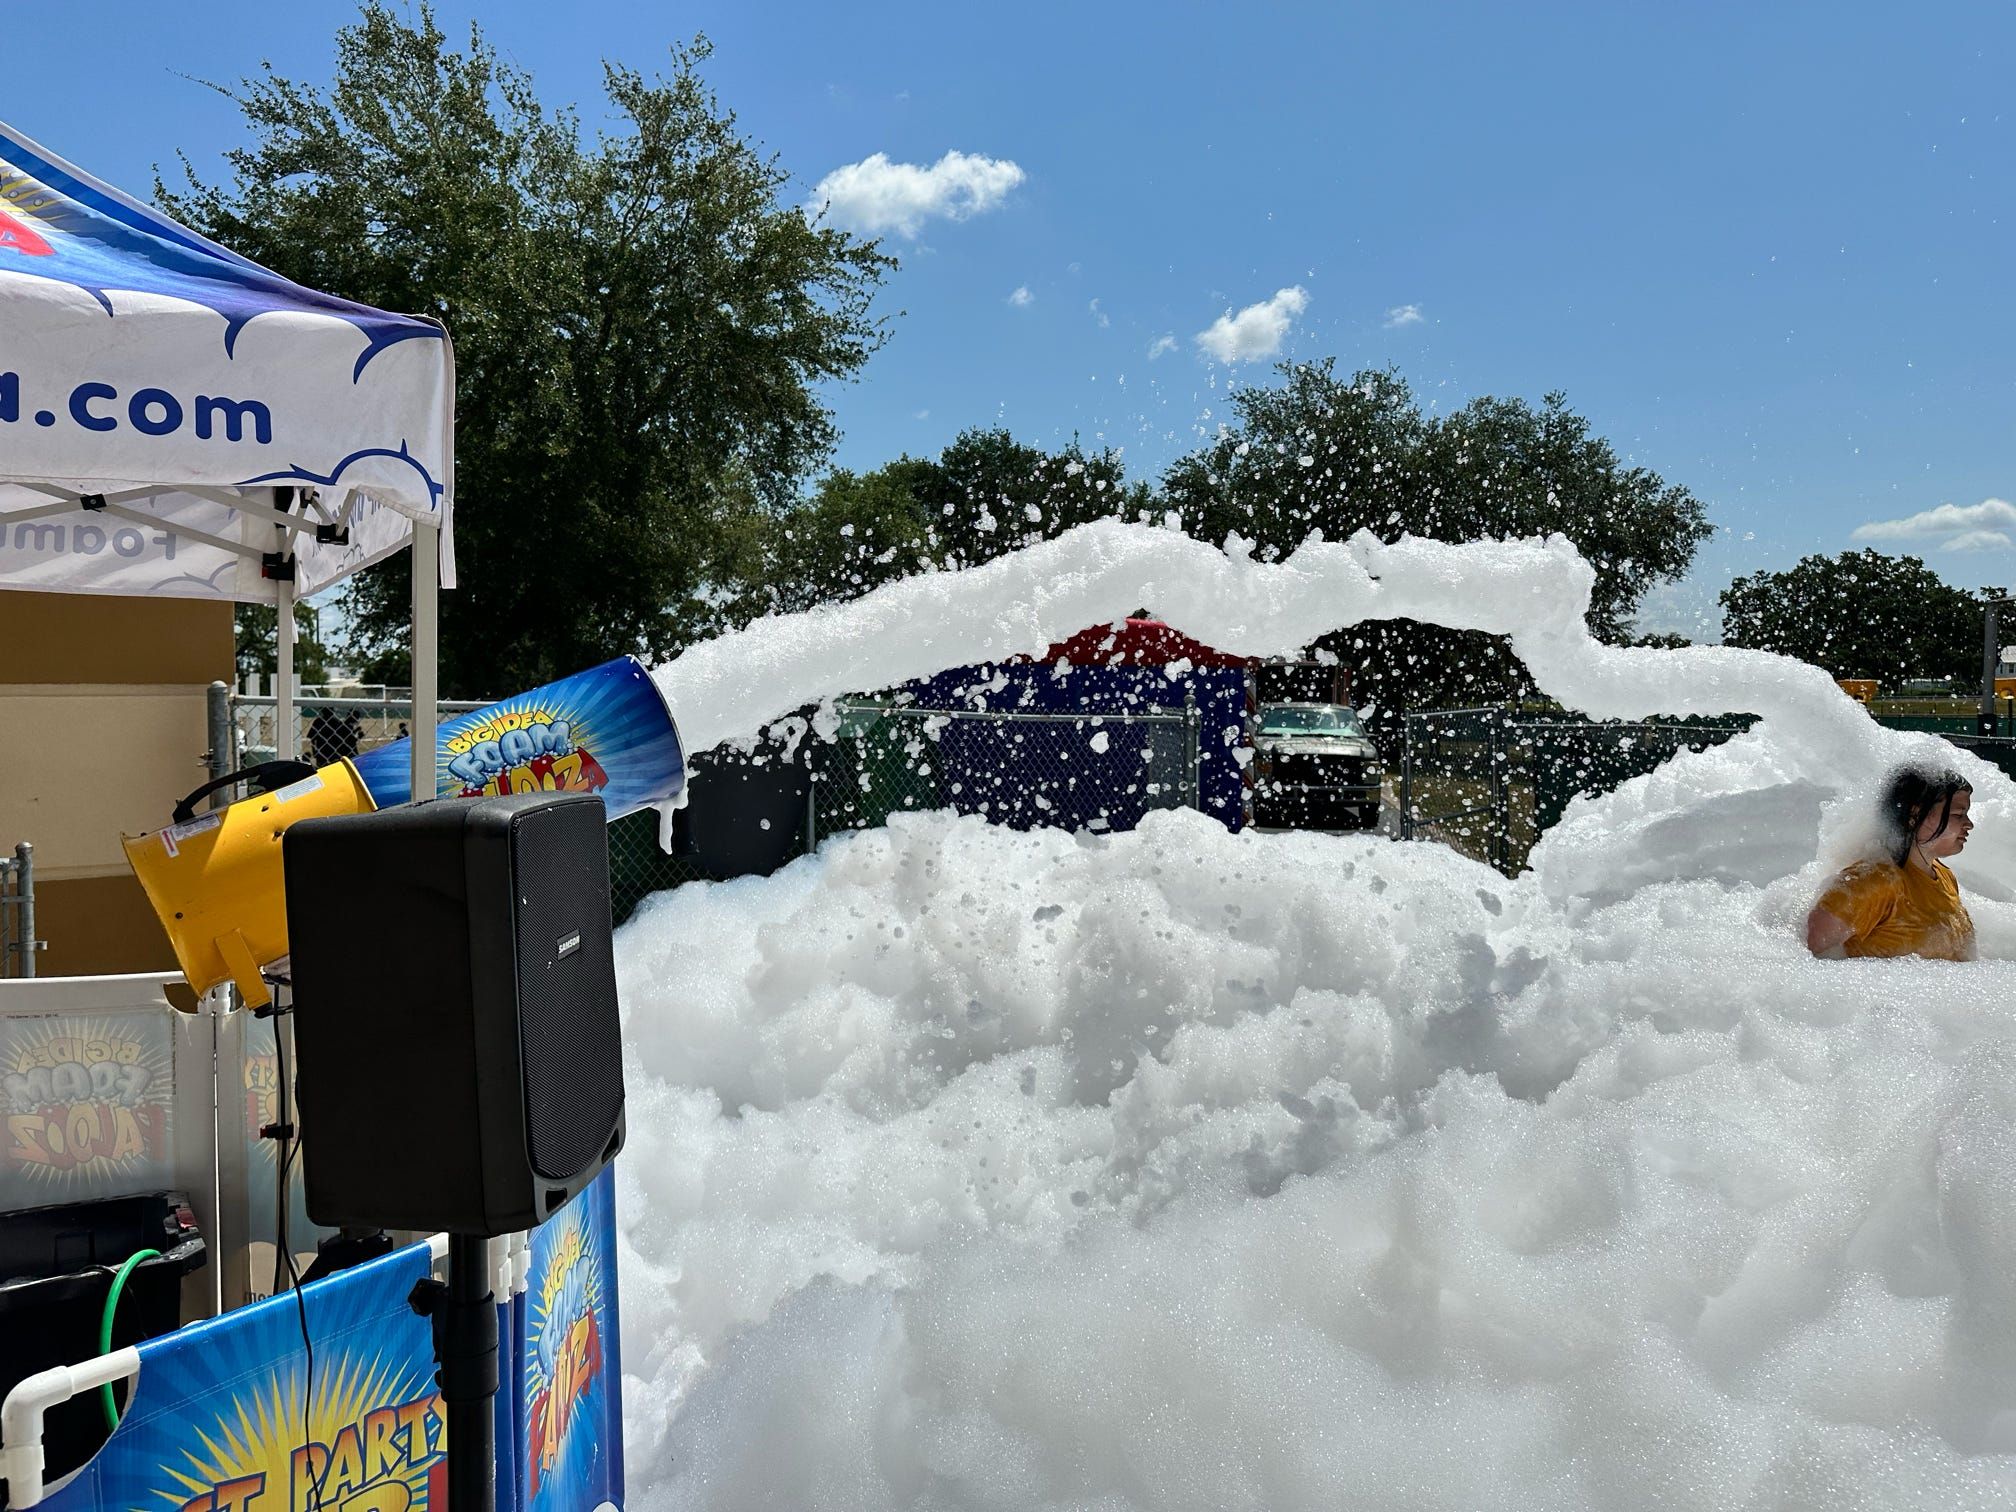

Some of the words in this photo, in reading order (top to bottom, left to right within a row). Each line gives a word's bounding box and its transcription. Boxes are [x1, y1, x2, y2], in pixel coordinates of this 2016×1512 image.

[447, 723, 498, 754] BIG
[494, 710, 555, 737] IDEA
[448, 719, 572, 786] FOAM
[558, 934, 581, 954] SAMSON
